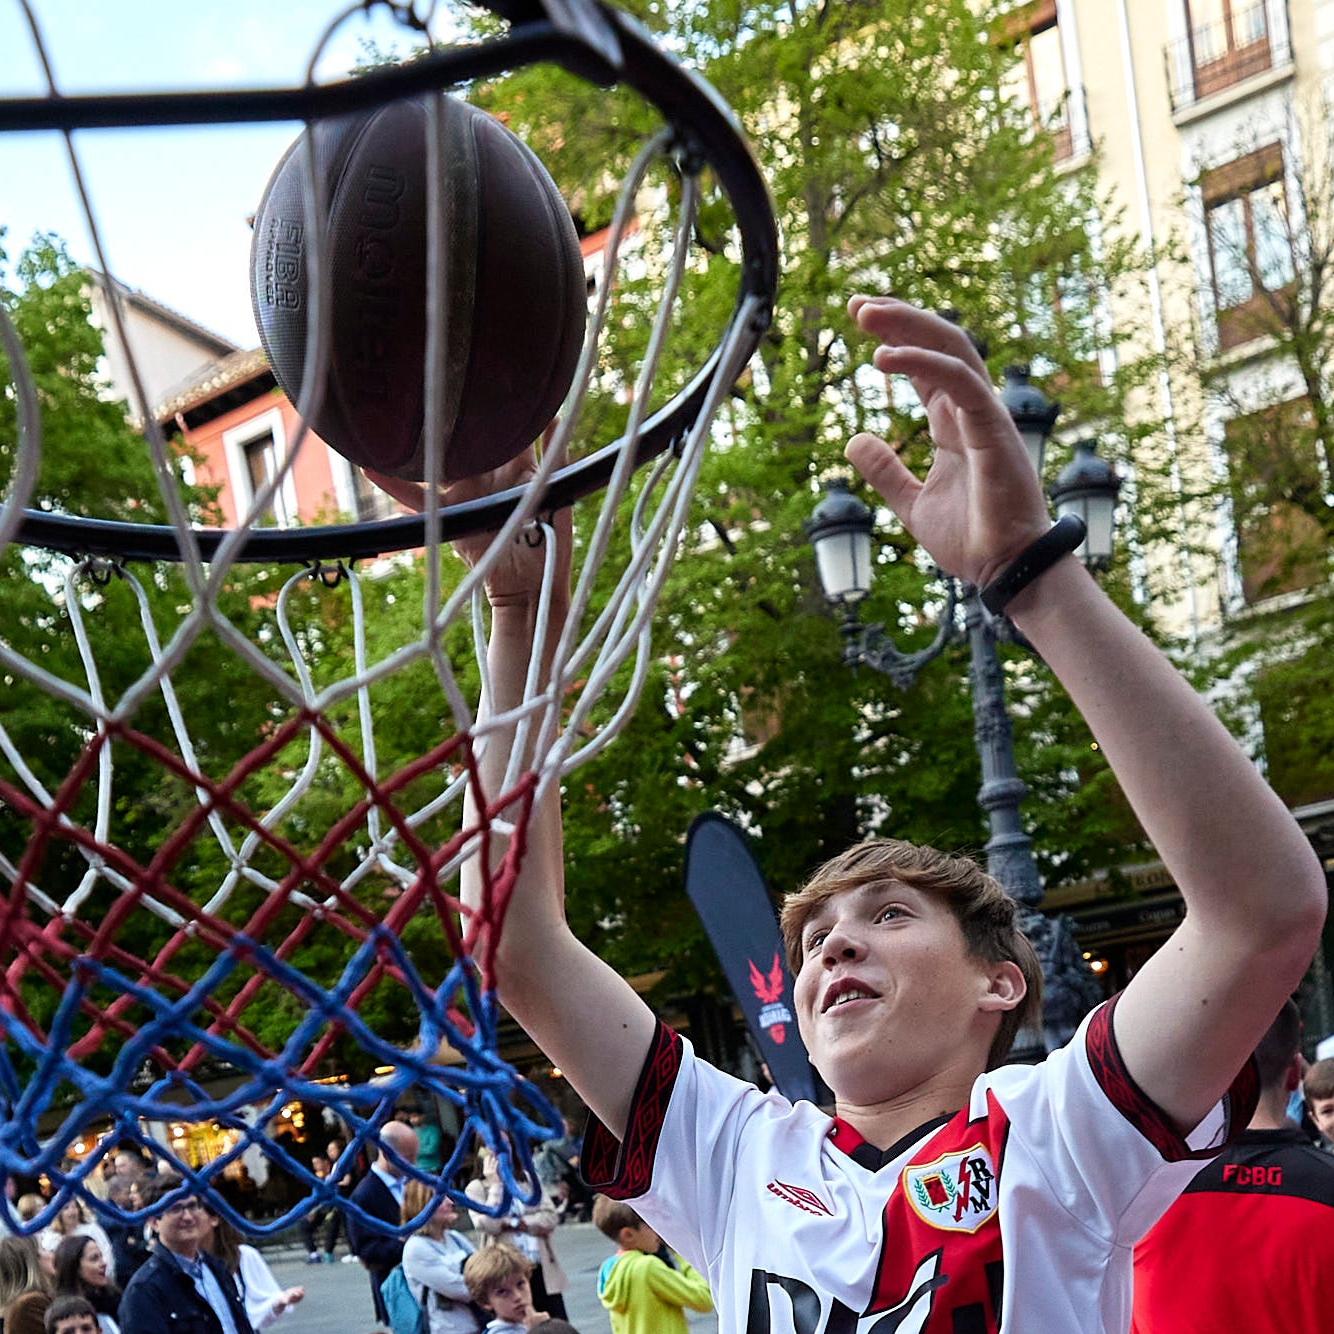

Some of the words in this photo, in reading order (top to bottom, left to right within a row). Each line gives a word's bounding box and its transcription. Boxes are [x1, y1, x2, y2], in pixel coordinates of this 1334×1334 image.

[275, 219, 304, 309] FIBA
[1222, 1163, 1283, 1186] FCBG
[766, 1182, 823, 1217] umbro
